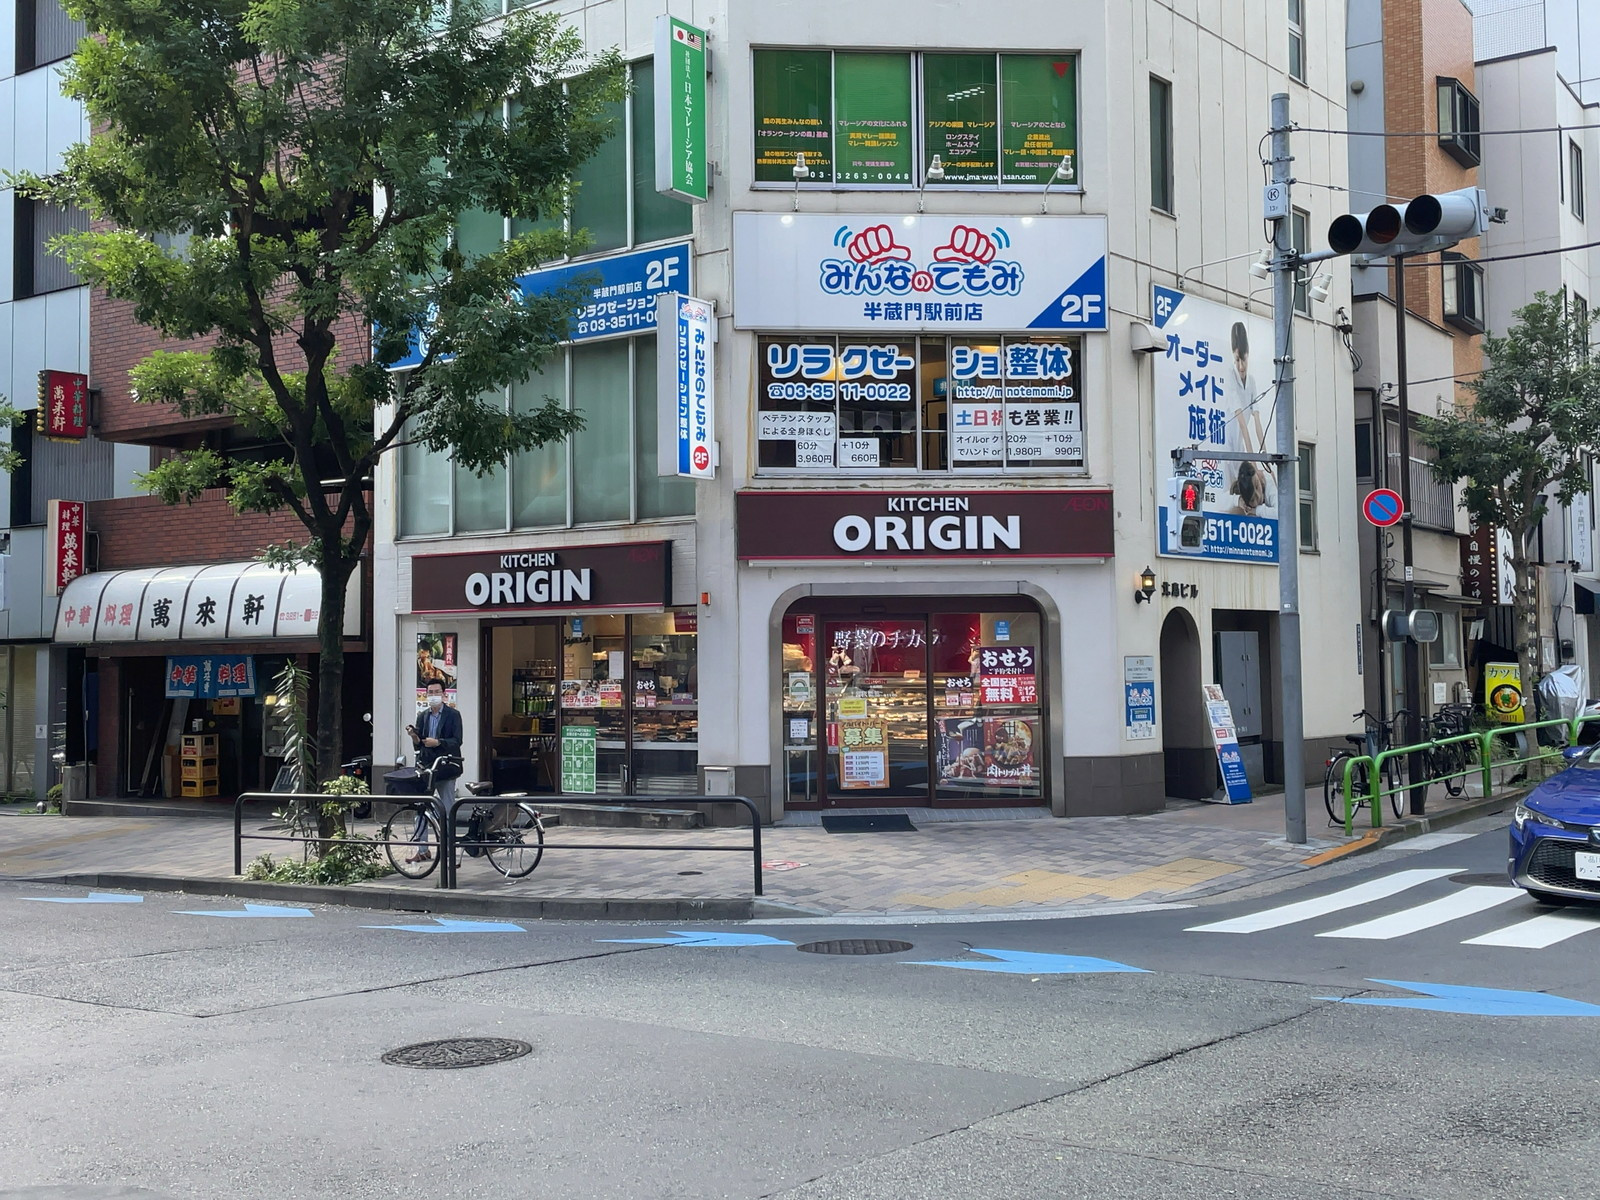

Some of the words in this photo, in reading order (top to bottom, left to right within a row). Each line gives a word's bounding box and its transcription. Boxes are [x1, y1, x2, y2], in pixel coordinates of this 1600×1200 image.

[683, 82, 694, 186] 日本マレーシア協会
[645, 256, 679, 290] 2F
[823, 261, 1021, 294] みんなのてもみ
[593, 281, 643, 300] 半蔵門駅前店
[864, 301, 983, 322] 半蔵門駅前店
[1060, 294, 1101, 323] 2F
[1156, 295, 1172, 318] 2F
[1166, 333, 1223, 368] オーダー
[679, 325, 689, 440] リラクゼーション整体
[694, 328, 708, 443] みんなのてもみ
[1178, 370, 1224, 404] メイド
[762, 414, 832, 423] ベテランスタッフ
[1188, 404, 1226, 445] 施術
[762, 427, 832, 436] による全身ほぐし
[797, 441, 818, 450] 60分
[958, 448, 989, 456] でハンド
[1054, 448, 1081, 456] 990円
[694, 453, 708, 464] 2F
[797, 454, 832, 463] 3,960円
[851, 454, 878, 463] 660円
[888, 496, 969, 512] KITCHEN
[61, 509, 71, 531] 料理
[832, 514, 1021, 551] ORIGIN
[500, 552, 556, 569] KITCHEN
[464, 568, 592, 606] ORIGIN
[982, 647, 1033, 667] おせち
[171, 664, 198, 687] 中華
[217, 662, 247, 686] 料理
[947, 677, 972, 688] おせち
[981, 677, 1018, 688] 全国配送
[636, 680, 656, 690] おせち
[985, 687, 1014, 702] 無料
[843, 727, 883, 745] 募集
